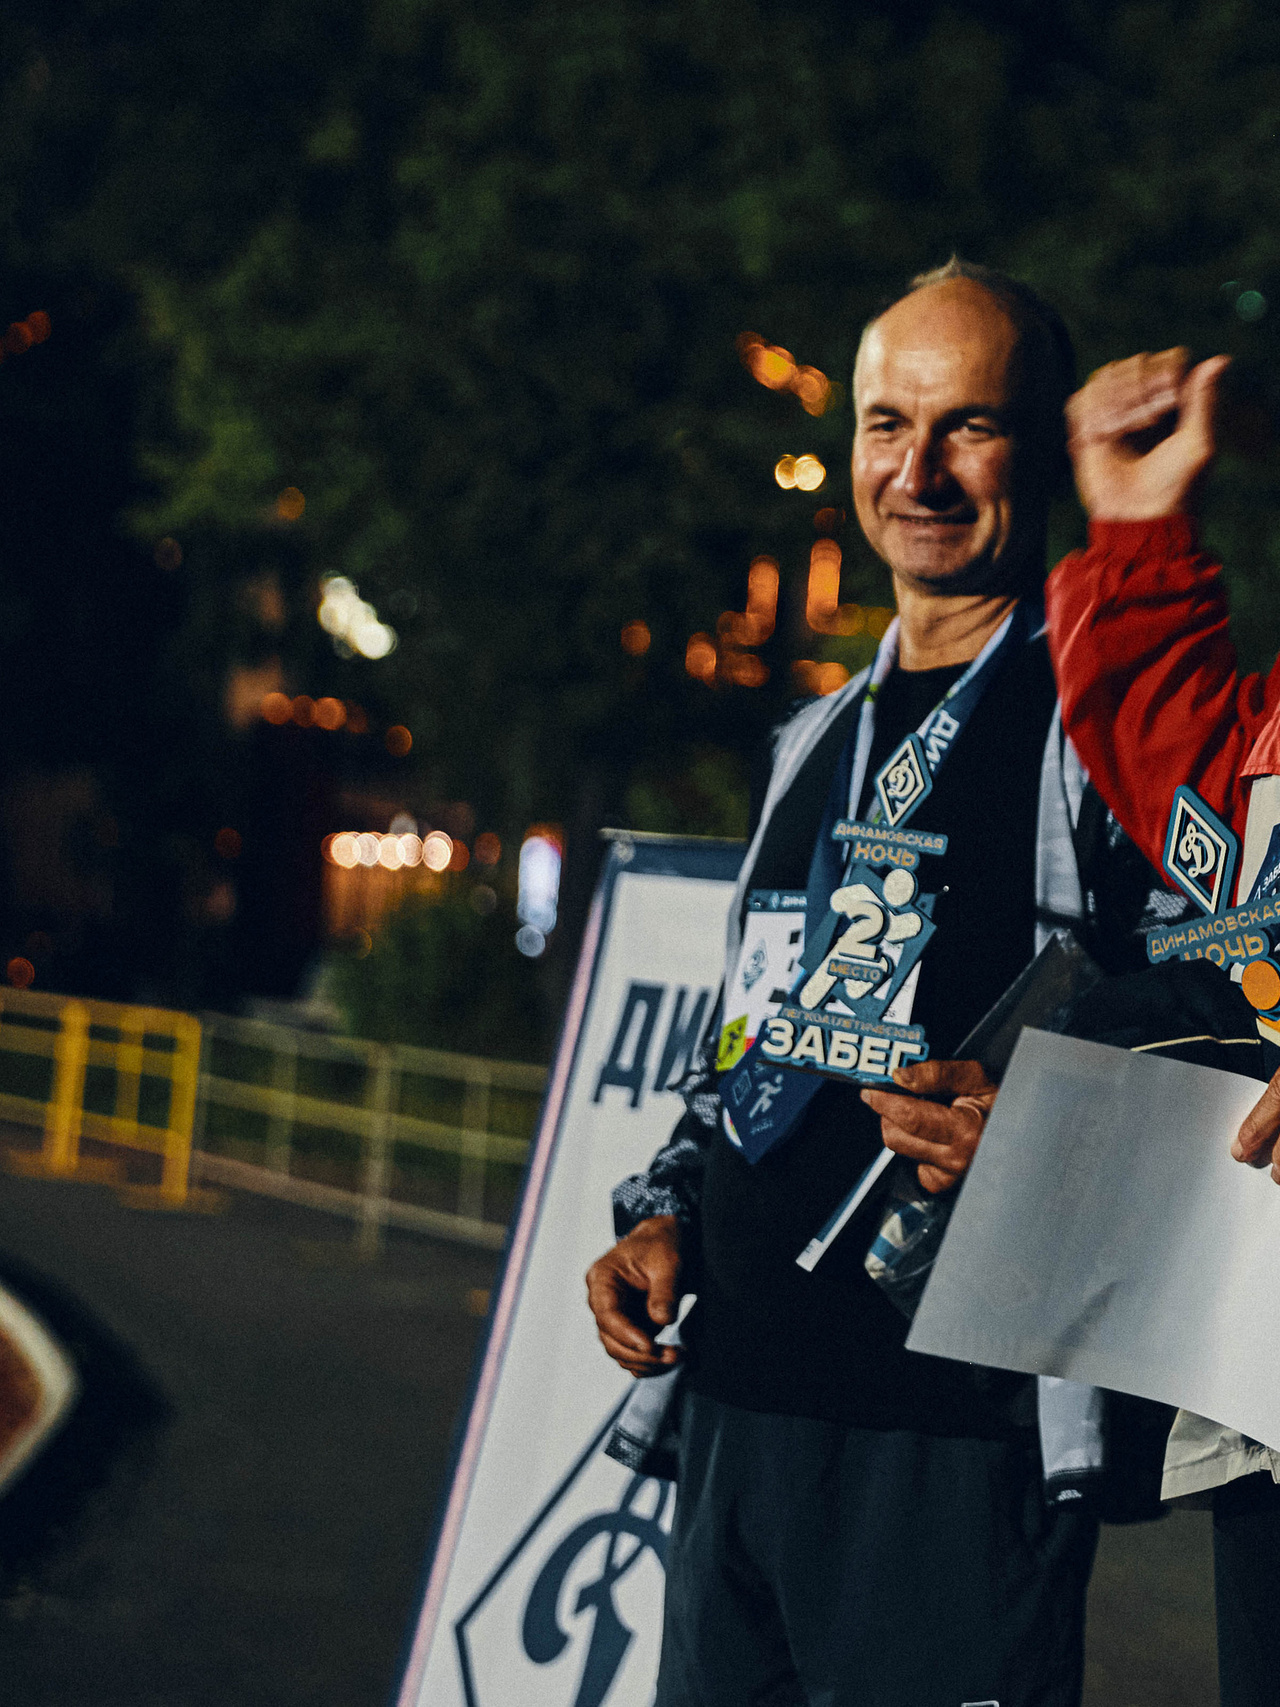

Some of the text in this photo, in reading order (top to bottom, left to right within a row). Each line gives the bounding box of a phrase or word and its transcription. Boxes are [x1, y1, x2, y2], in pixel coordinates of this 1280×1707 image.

[926, 708, 960, 772] ДИ
[834, 822, 944, 850] ДИНАМОВСКАЯ
[853, 841, 916, 867] НОЧЬ
[838, 901, 884, 960] 2
[828, 962, 882, 982] МЕСТО
[761, 1018, 922, 1077] ЗАБЕГ
